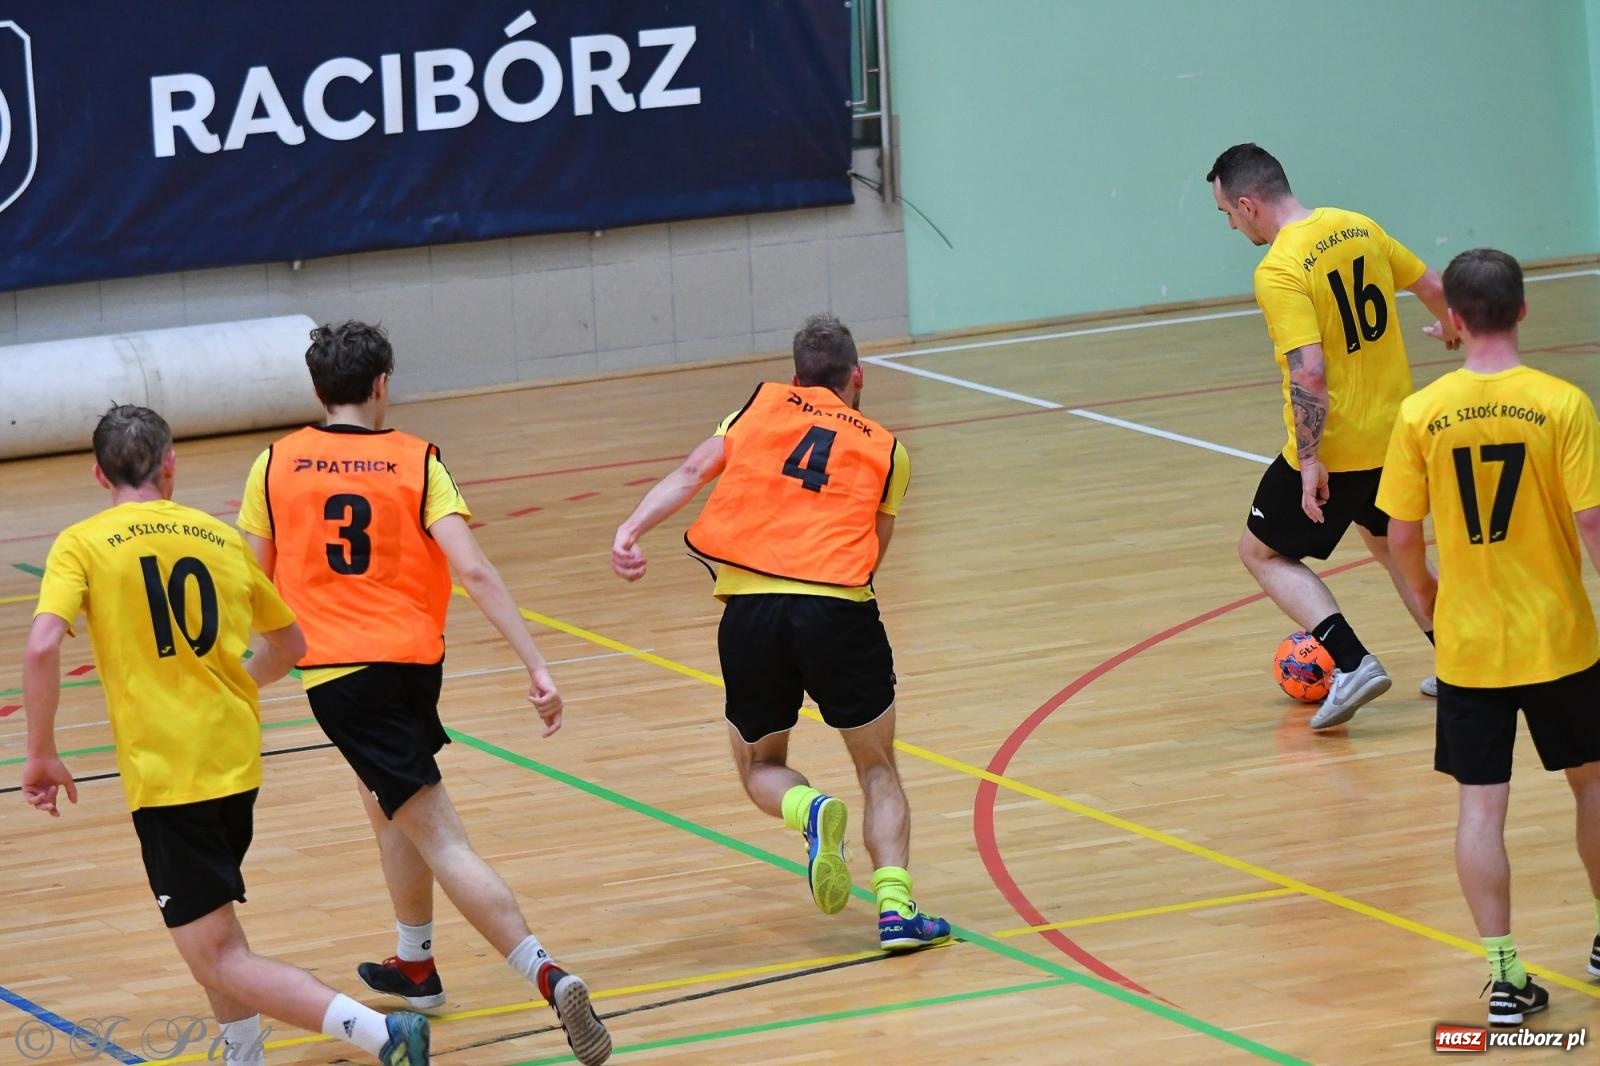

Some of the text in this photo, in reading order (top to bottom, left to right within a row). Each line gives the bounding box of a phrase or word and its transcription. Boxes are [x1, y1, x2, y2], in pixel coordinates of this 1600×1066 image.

[150, 10, 702, 158] RACIBÓRZ
[1327, 255, 1388, 355] 16
[1501, 404, 1547, 427] ROGÓW
[316, 460, 398, 474] PATRICK
[782, 425, 837, 493] 4
[1452, 442, 1526, 545] 17
[183, 524, 226, 548] ROGÓW
[324, 493, 372, 575] 3
[139, 555, 219, 659] 10
